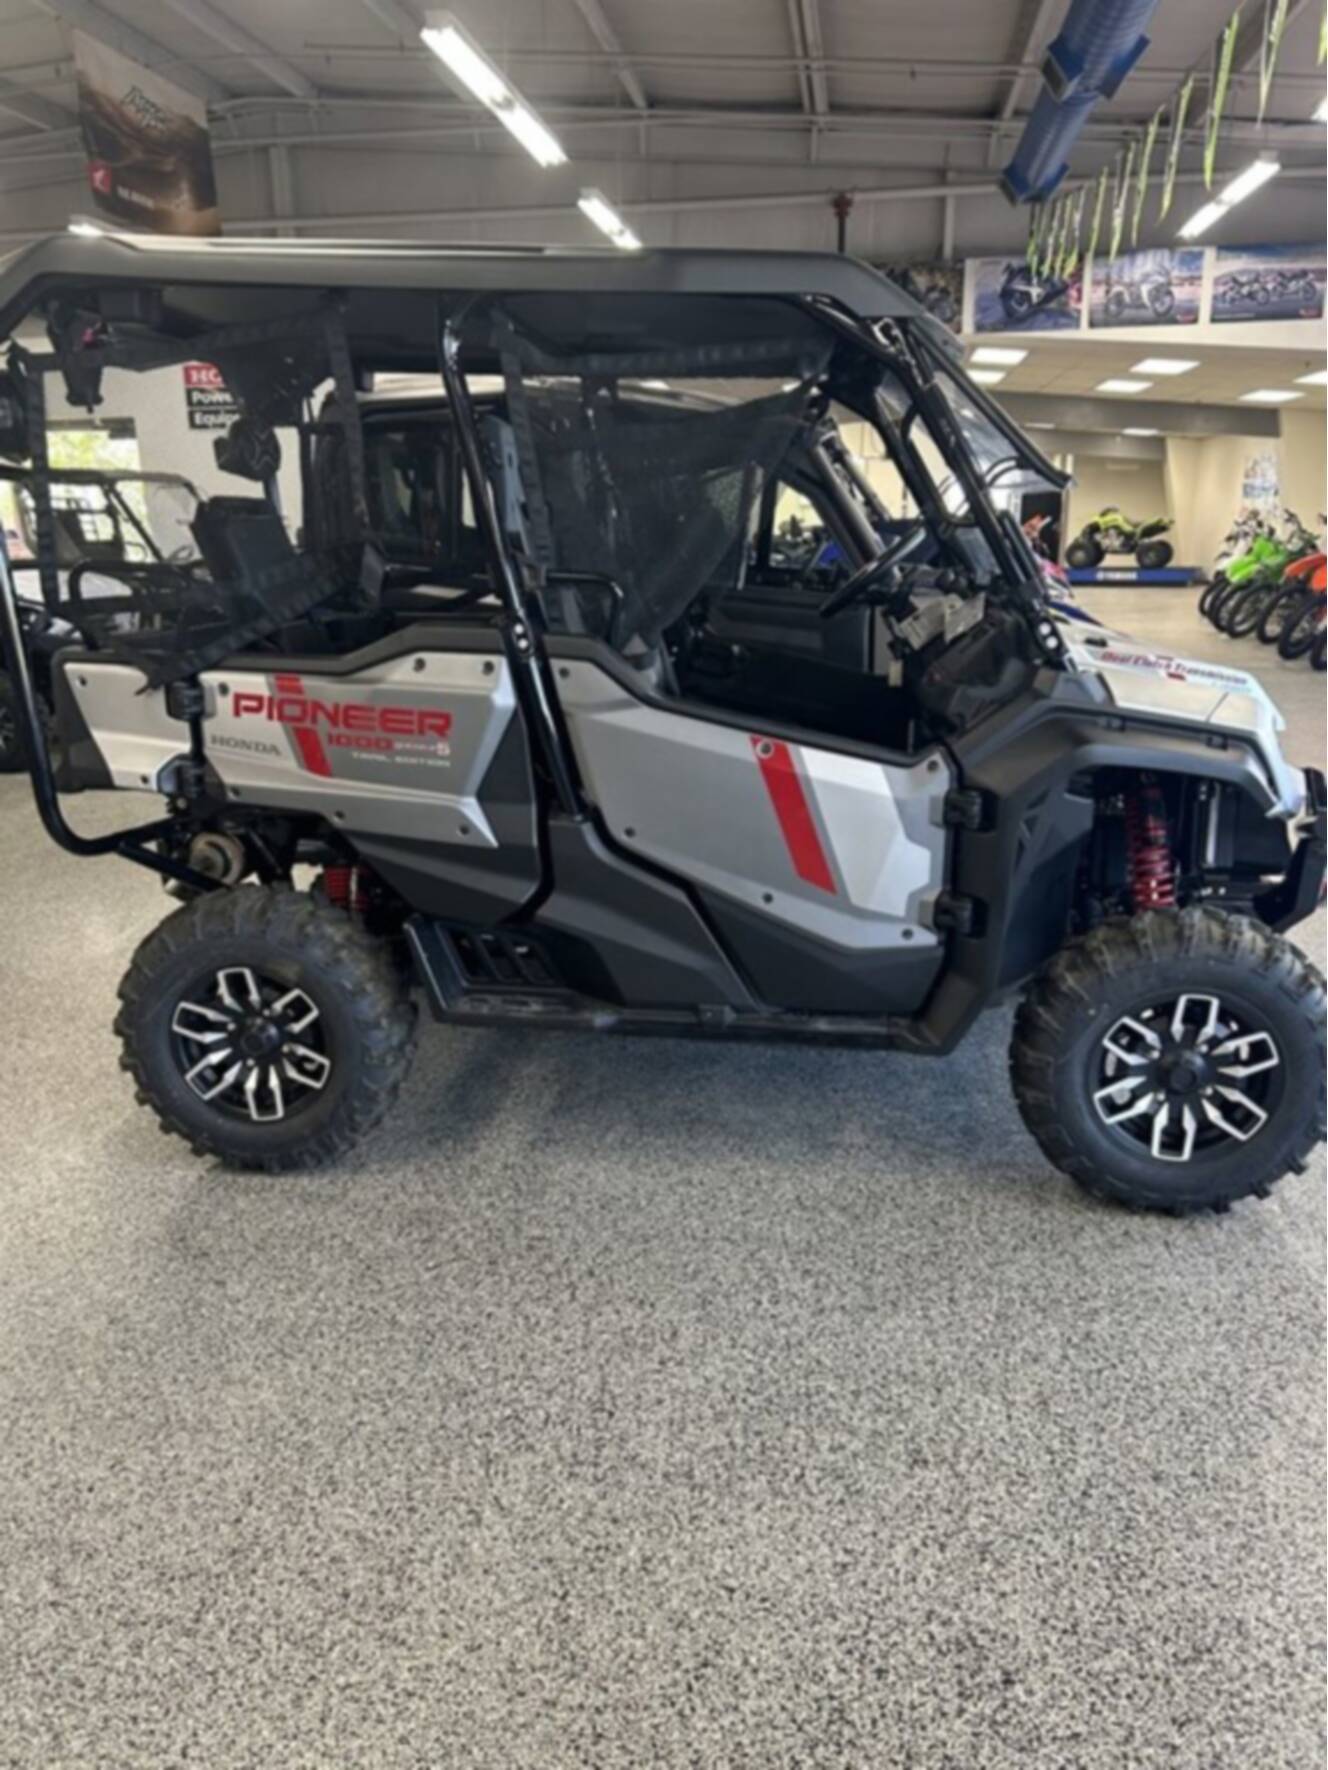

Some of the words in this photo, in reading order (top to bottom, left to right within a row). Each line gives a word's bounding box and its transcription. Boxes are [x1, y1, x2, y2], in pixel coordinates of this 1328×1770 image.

[192, 391, 235, 404] Powe
[233, 692, 453, 738] PIONEER
[210, 733, 281, 756] HONDA
